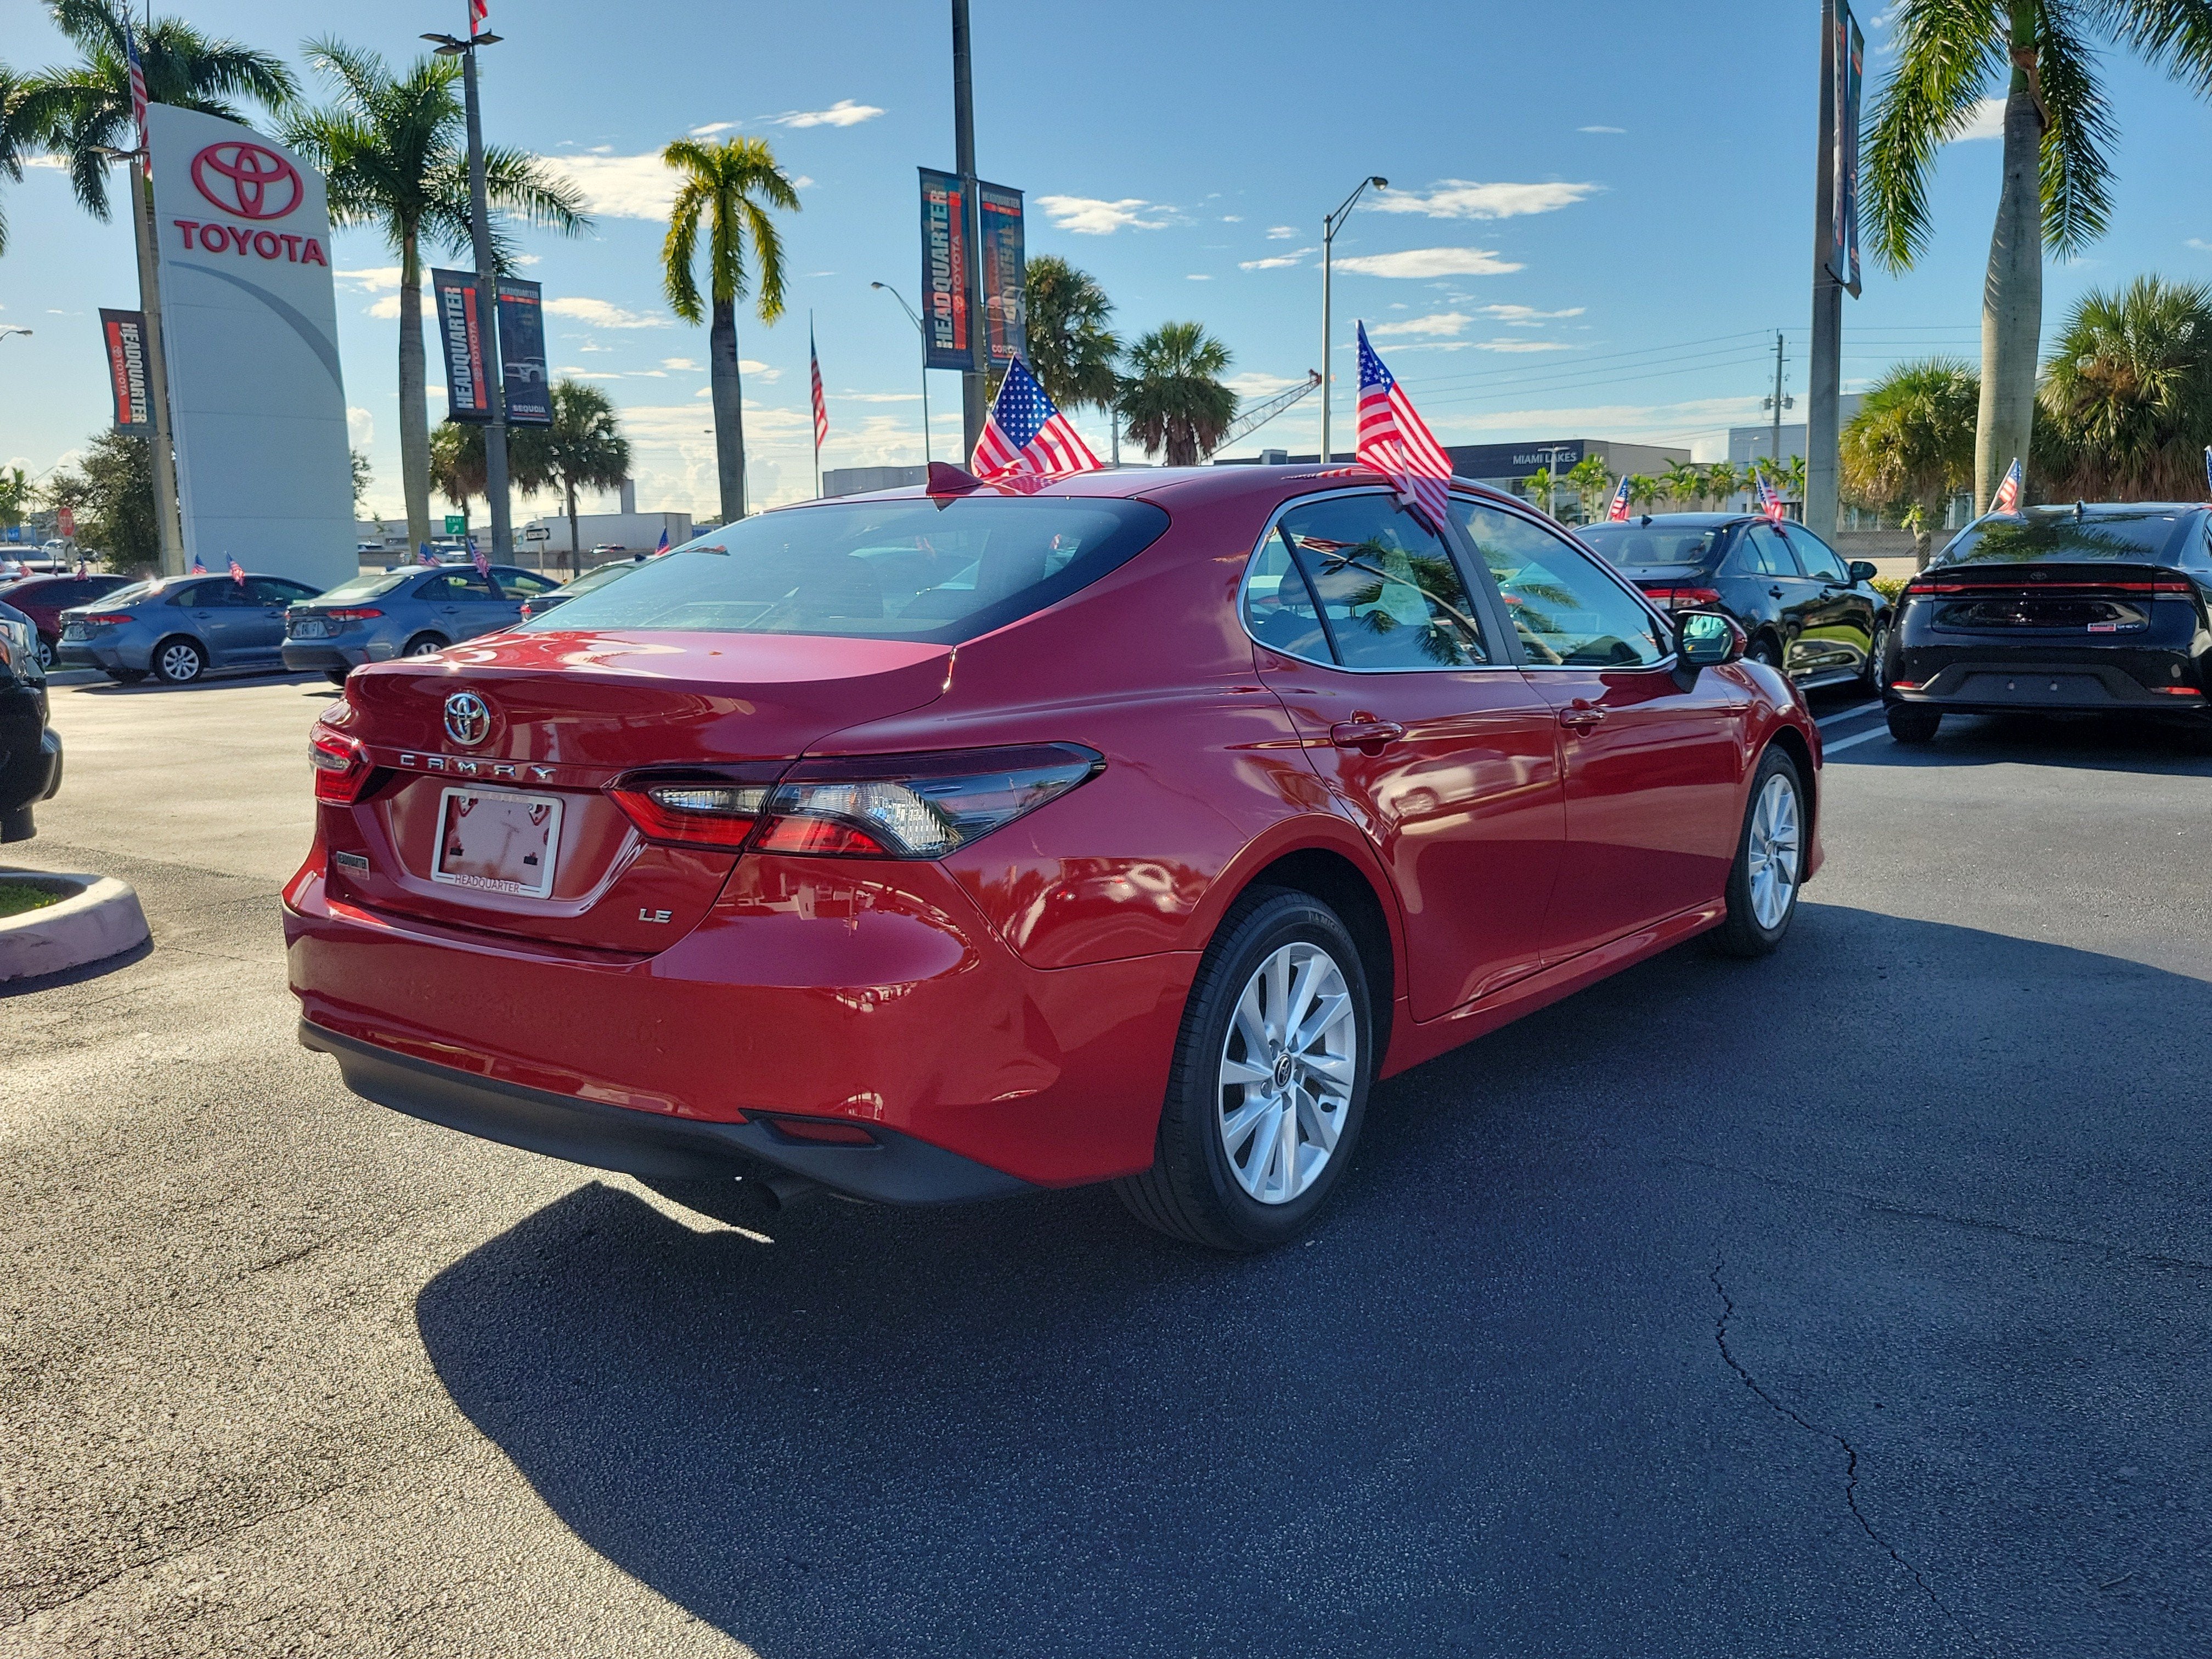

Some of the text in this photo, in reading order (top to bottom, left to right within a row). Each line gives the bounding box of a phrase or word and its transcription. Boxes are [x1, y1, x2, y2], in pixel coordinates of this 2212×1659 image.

[174, 220, 328, 266] TOYOTA
[930, 190, 953, 349] HEADQUARTER
[951, 235, 962, 295] TOYOTA
[444, 287, 475, 409] HEADQUARTER
[468, 321, 480, 365] TOYOTA
[116, 358, 127, 396] TOYOTA
[120, 323, 147, 424] HEADQUARTER
[513, 404, 546, 413] SEQUOIA
[1513, 452, 1577, 464] MIAMI LKES
[400, 754, 557, 779] CAMRY
[454, 875, 520, 893] HEADQUARTER
[639, 909, 673, 923] LE
